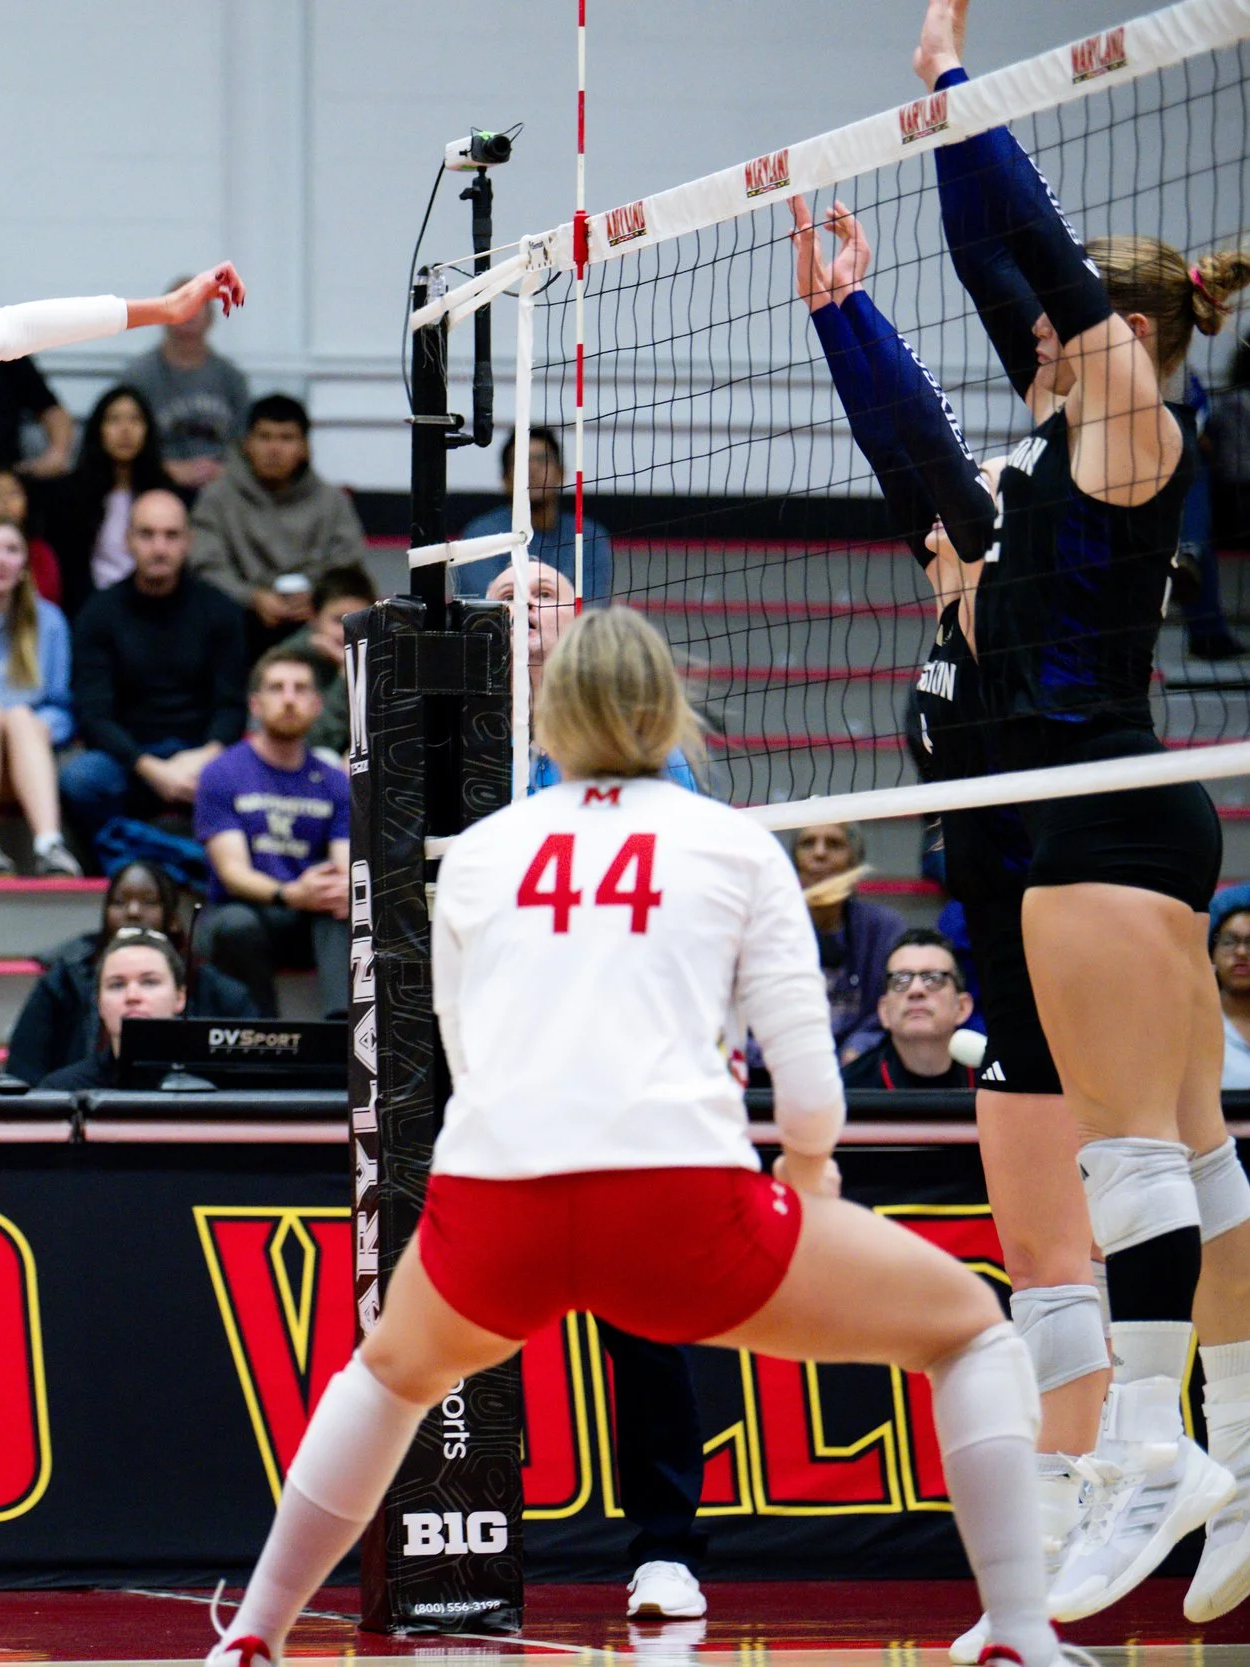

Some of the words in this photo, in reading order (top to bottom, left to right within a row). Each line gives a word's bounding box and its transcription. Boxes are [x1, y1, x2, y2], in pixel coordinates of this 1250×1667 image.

[582, 786, 622, 808] M
[516, 832, 663, 934] 44
[352, 859, 379, 1337] ARYLAND
[414, 1602, 445, 1615] (800)
